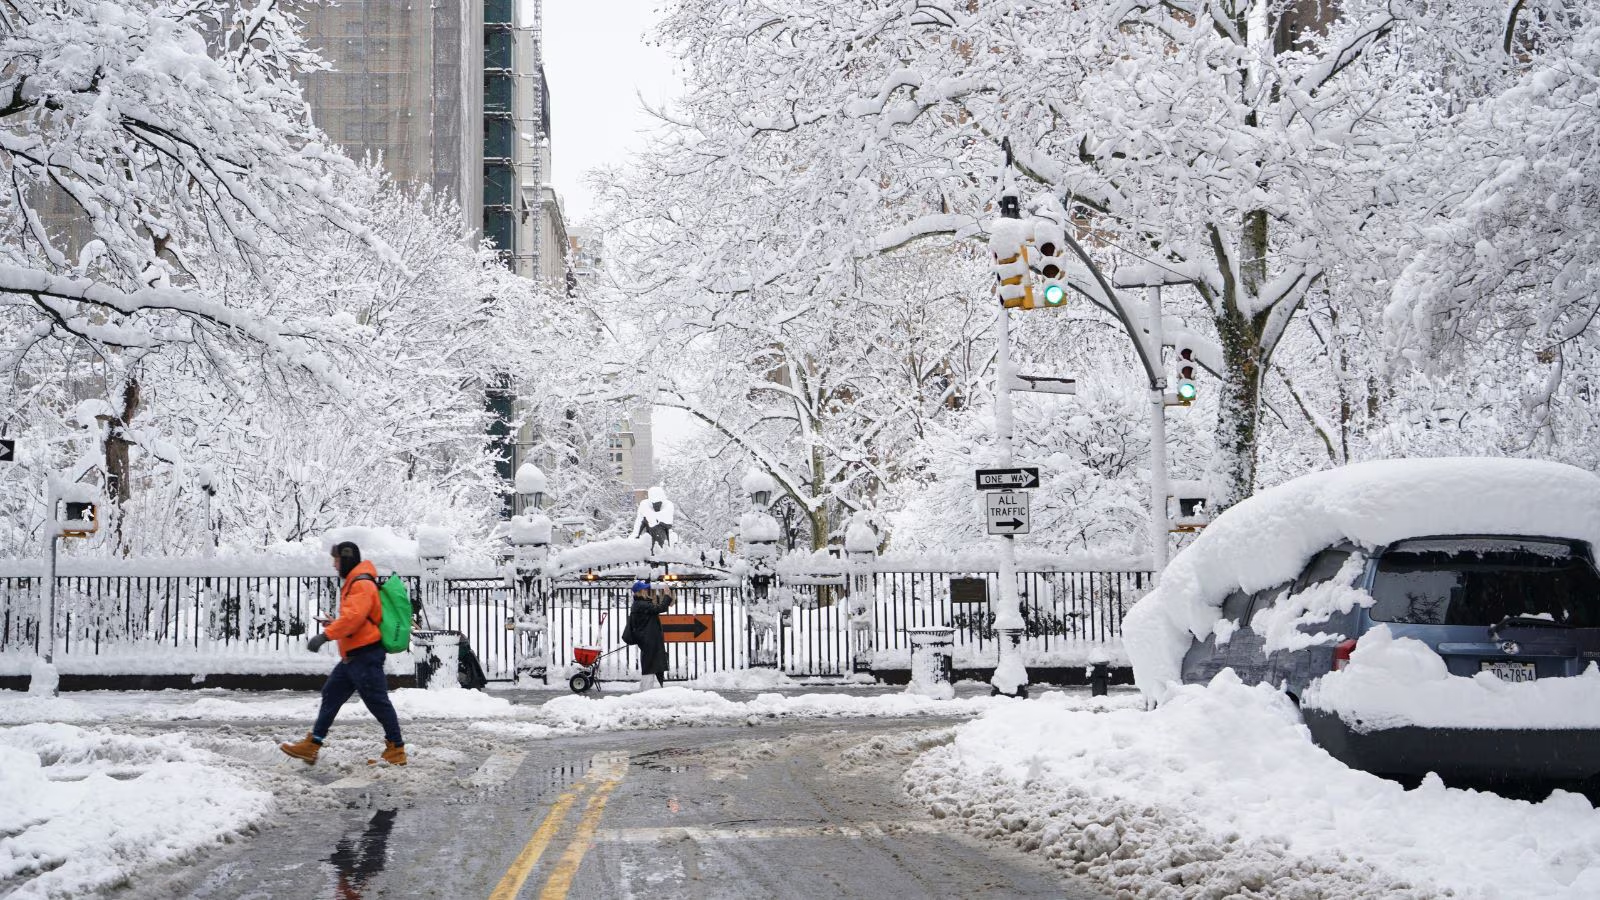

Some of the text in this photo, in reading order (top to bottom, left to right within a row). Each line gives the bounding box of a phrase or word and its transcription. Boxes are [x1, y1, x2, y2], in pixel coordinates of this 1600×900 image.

[985, 474, 1029, 484] ONE WAY
[998, 495, 1017, 505] ALL
[990, 507, 1026, 516] TRAFFIC
